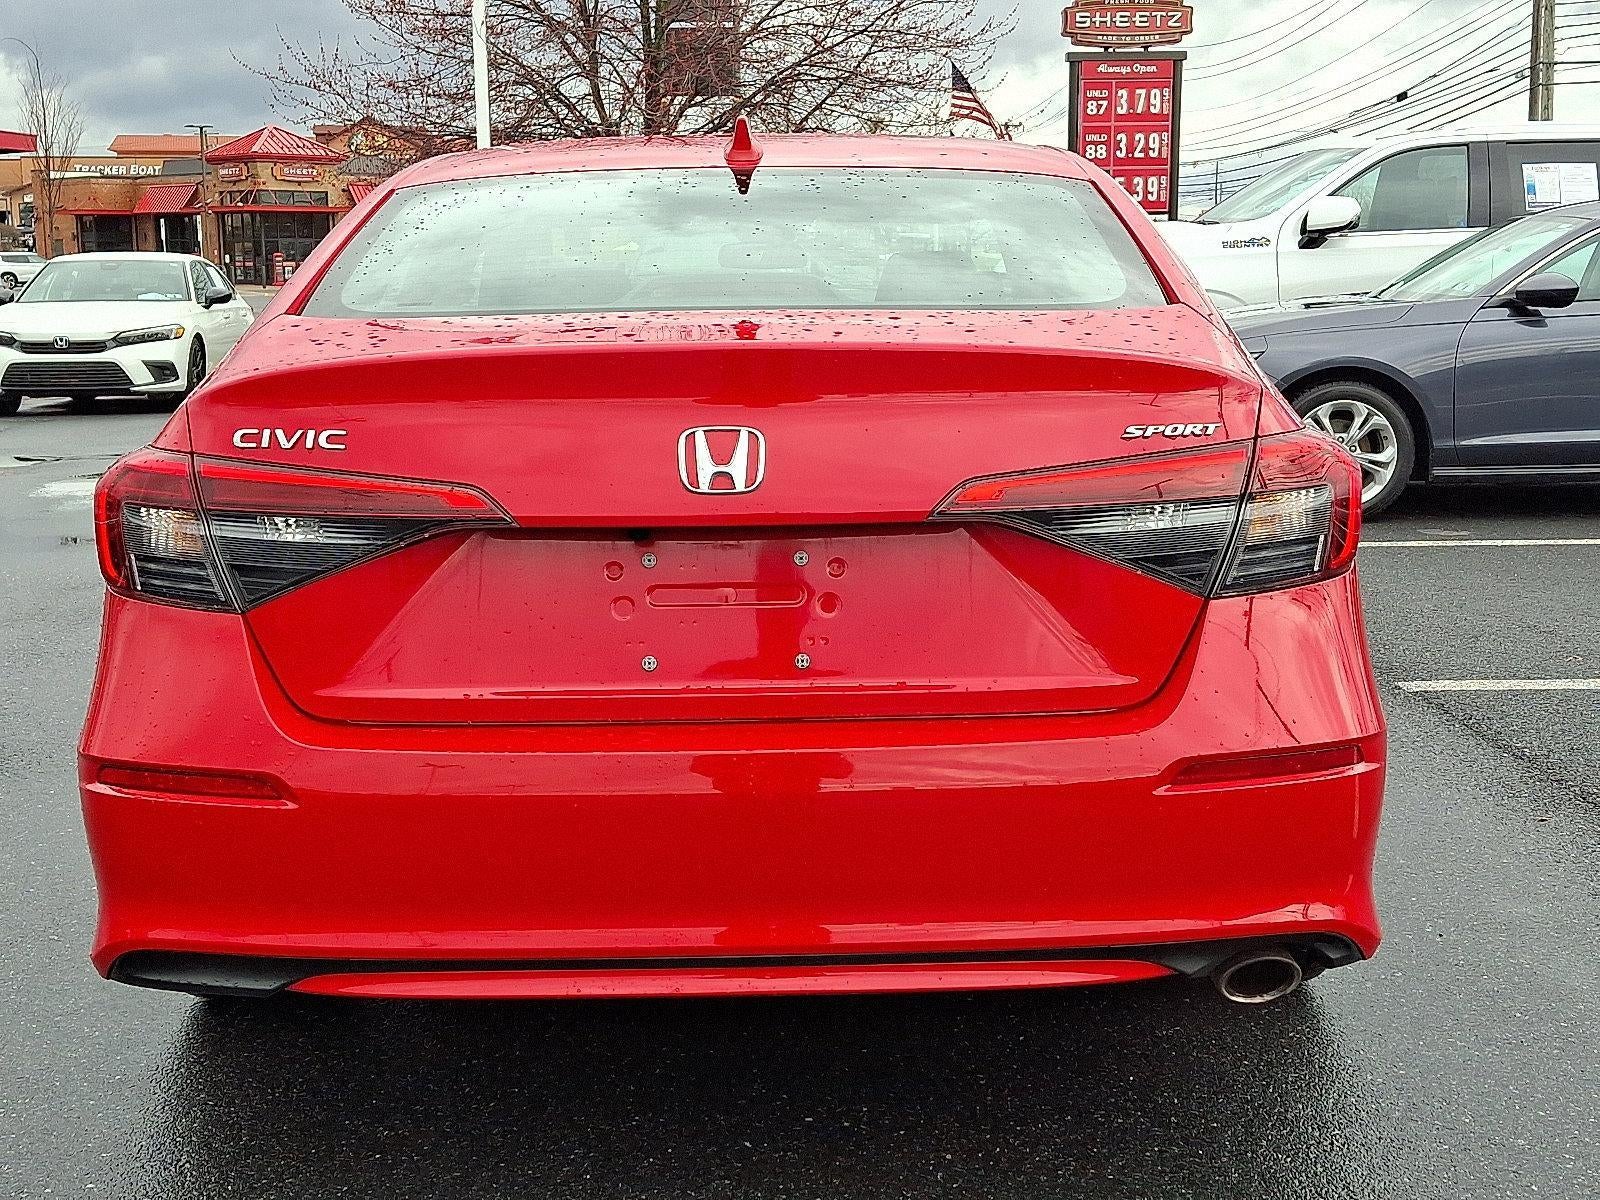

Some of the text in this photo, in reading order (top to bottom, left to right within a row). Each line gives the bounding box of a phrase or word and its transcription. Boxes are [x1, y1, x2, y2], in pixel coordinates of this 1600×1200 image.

[1075, 11, 1183, 28] SHEETZ
[1096, 63, 1157, 74] Always Open
[1086, 100, 1108, 115] 87
[1085, 133, 1107, 141] UNLD
[1085, 144, 1107, 159] 88
[74, 164, 127, 175] TRACKER
[1121, 423, 1221, 438] SPORT
[232, 428, 347, 449] CIVIC
